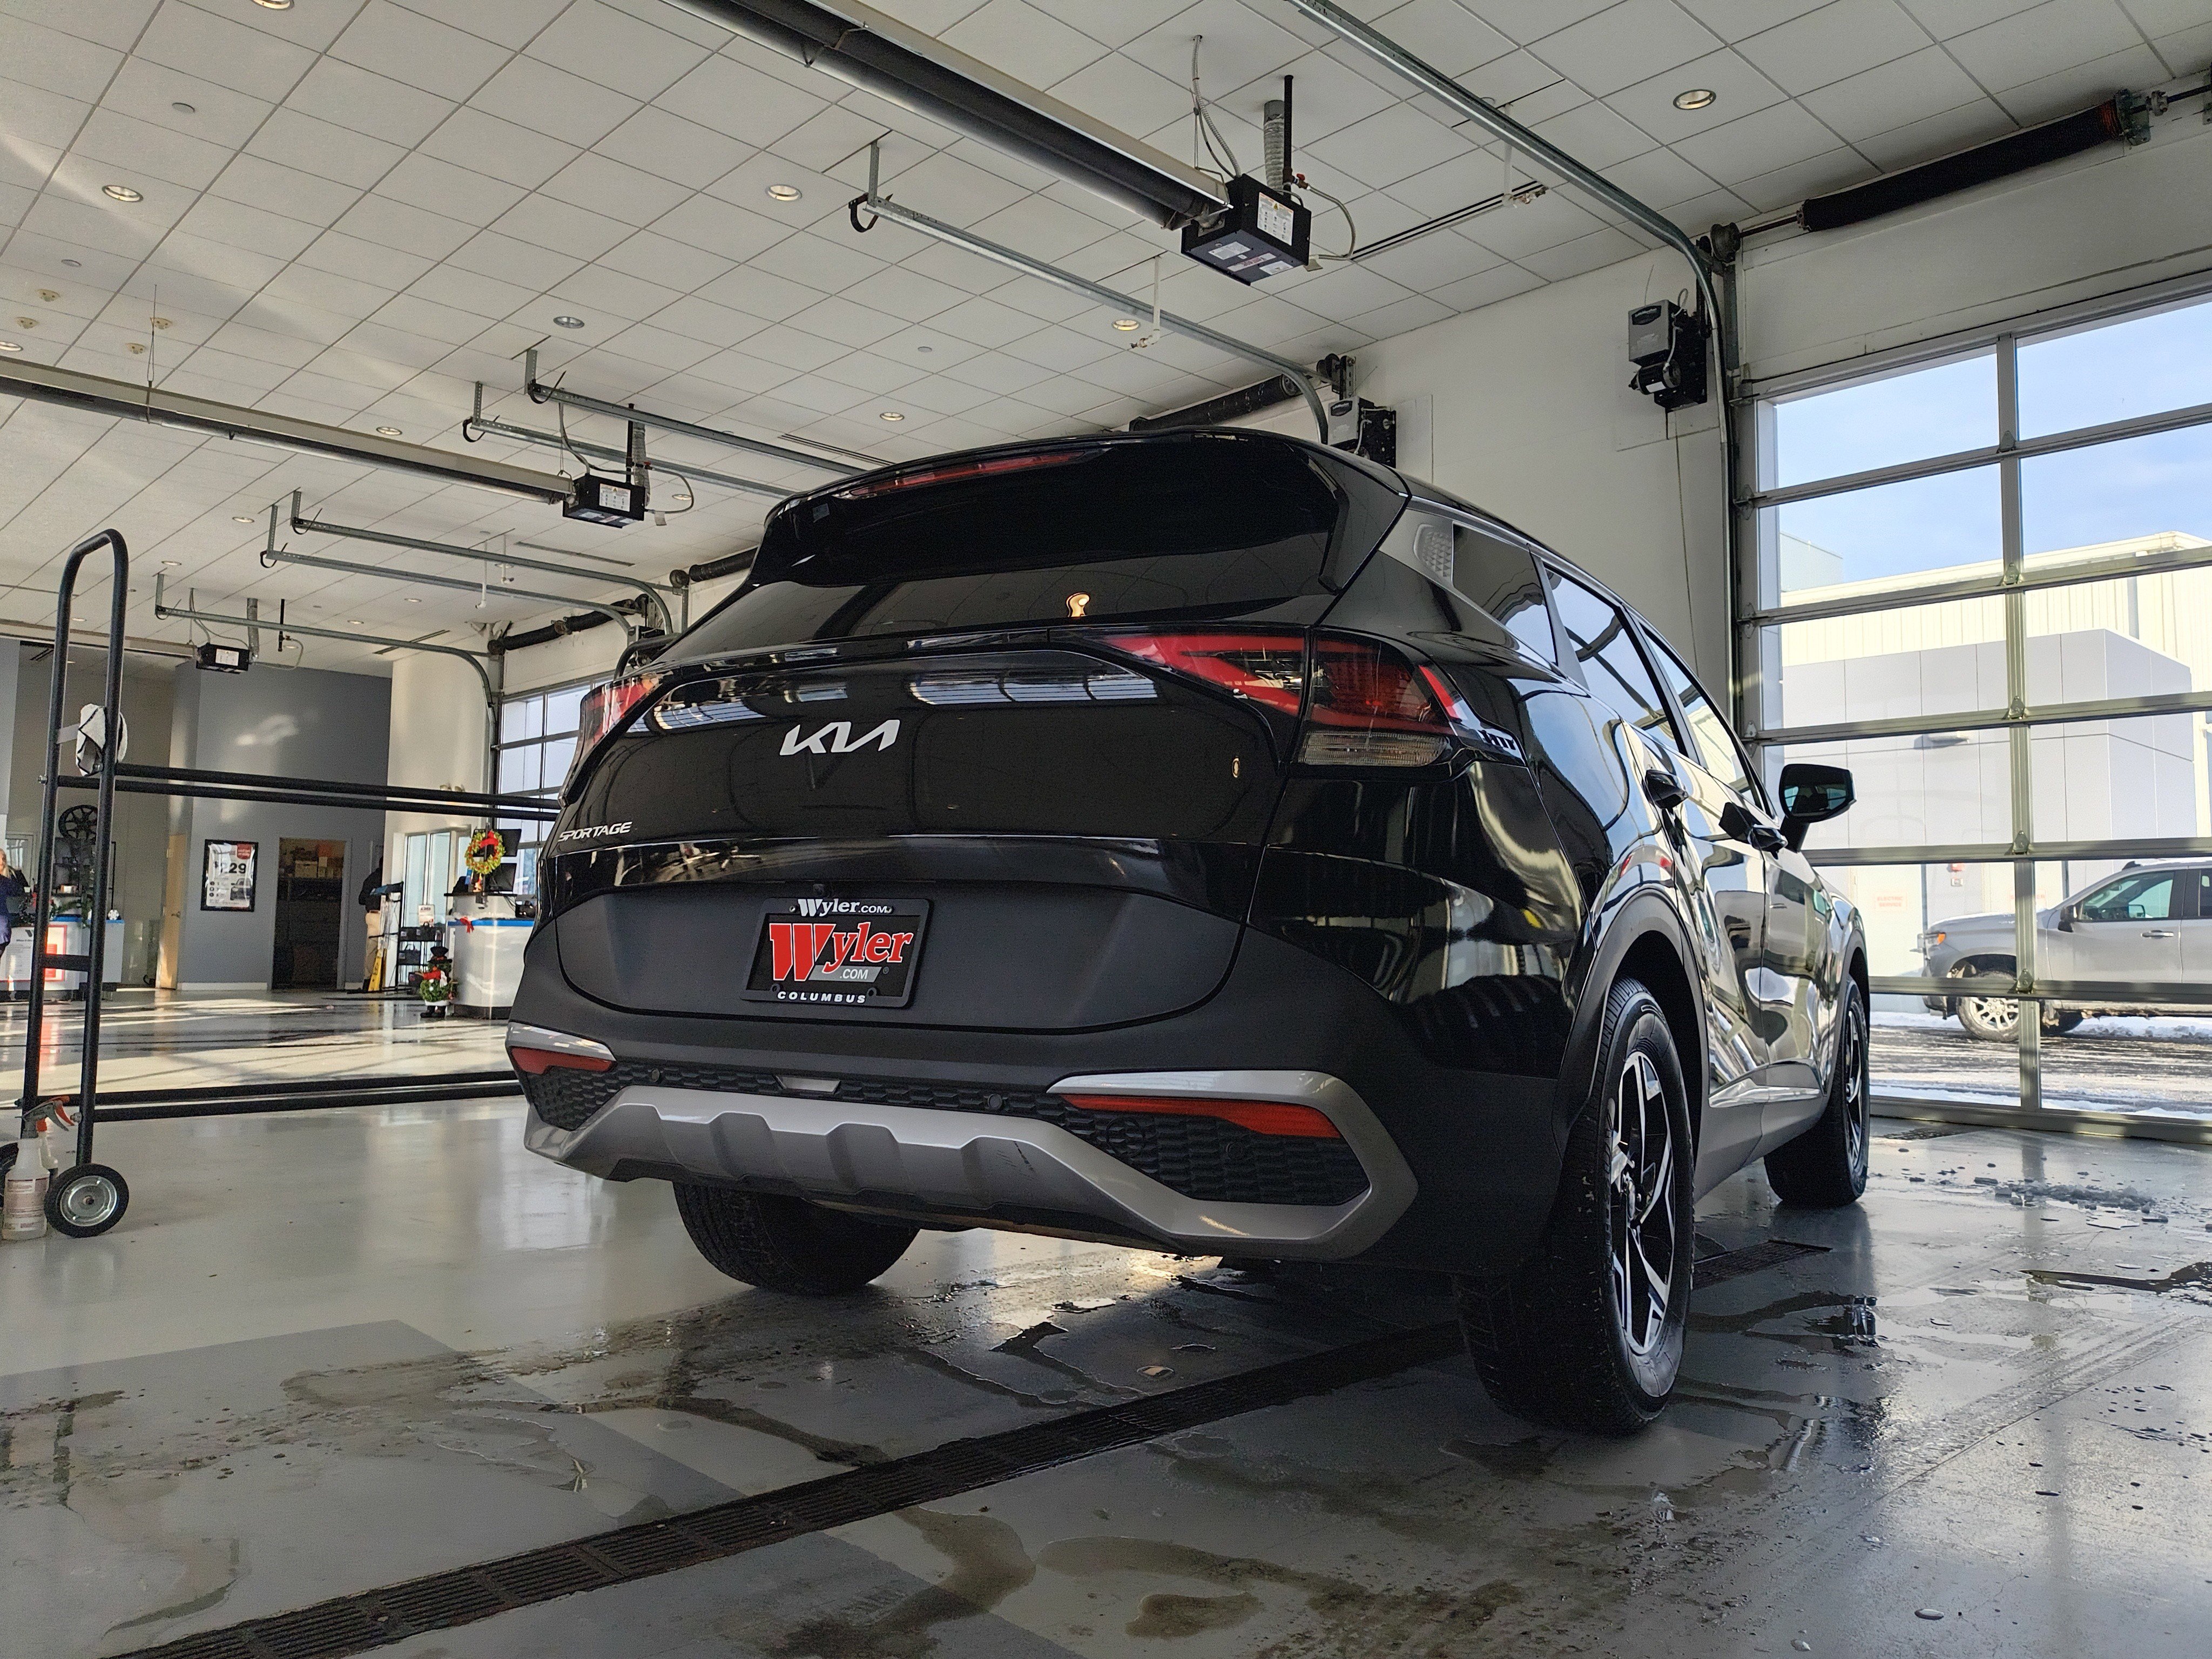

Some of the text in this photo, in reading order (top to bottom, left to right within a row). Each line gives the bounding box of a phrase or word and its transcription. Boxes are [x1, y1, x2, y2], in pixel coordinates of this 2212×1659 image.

[779, 719, 900, 756] KIA
[558, 821, 633, 842] SPORTAGE
[769, 922, 914, 982] Wyler
[840, 969, 869, 980] .COM
[777, 991, 866, 1003] COLUMBUS
